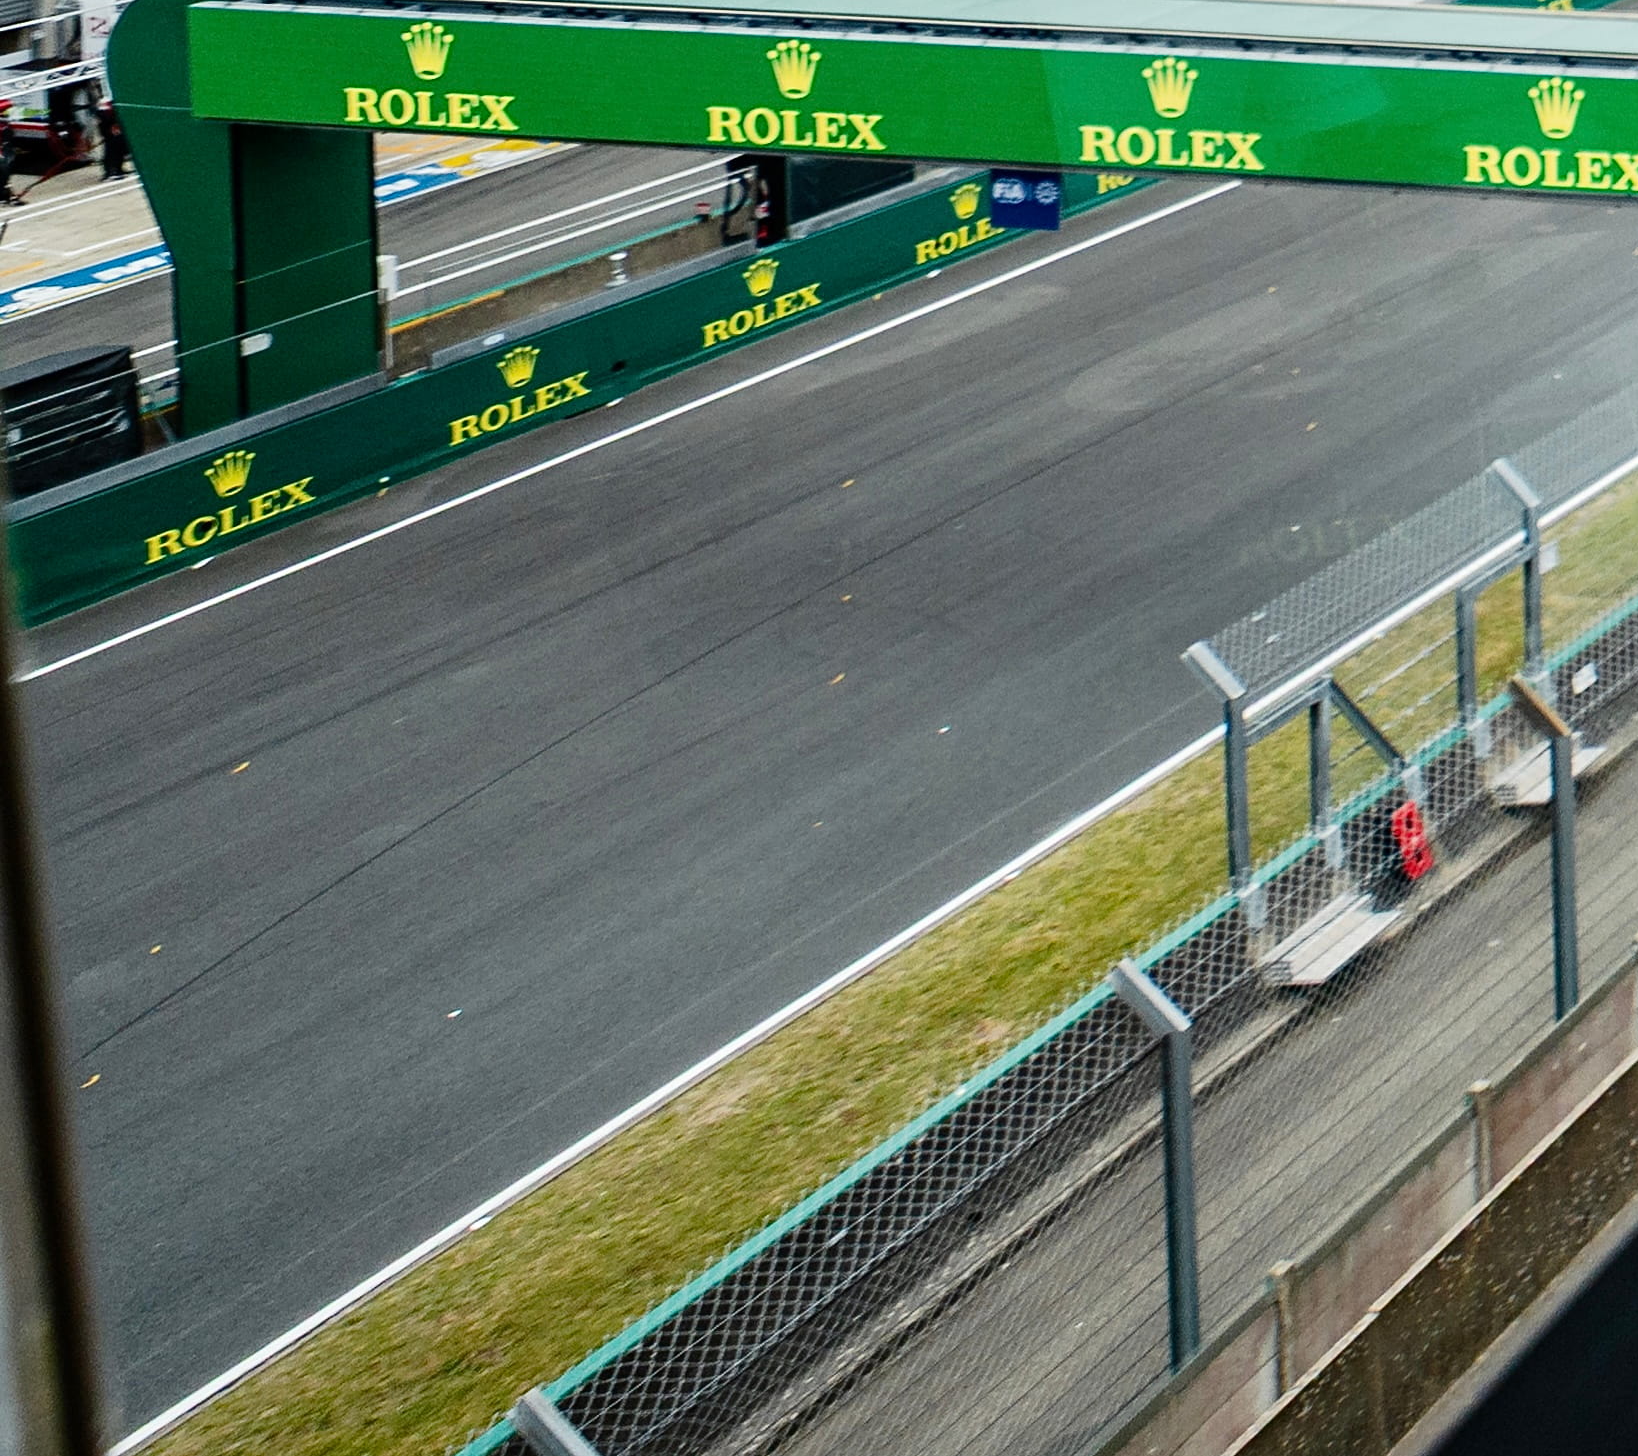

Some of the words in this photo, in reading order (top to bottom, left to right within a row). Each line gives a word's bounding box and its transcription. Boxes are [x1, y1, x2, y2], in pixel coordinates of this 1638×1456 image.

[344, 86, 518, 133] ROLEX
[707, 105, 886, 152] ROLEX
[1079, 124, 1265, 172] ROLEX
[916, 217, 1005, 265] ROLE
[702, 282, 822, 348] ROLEX
[449, 371, 590, 446] ROLEX
[144, 475, 315, 566] ROLEX
